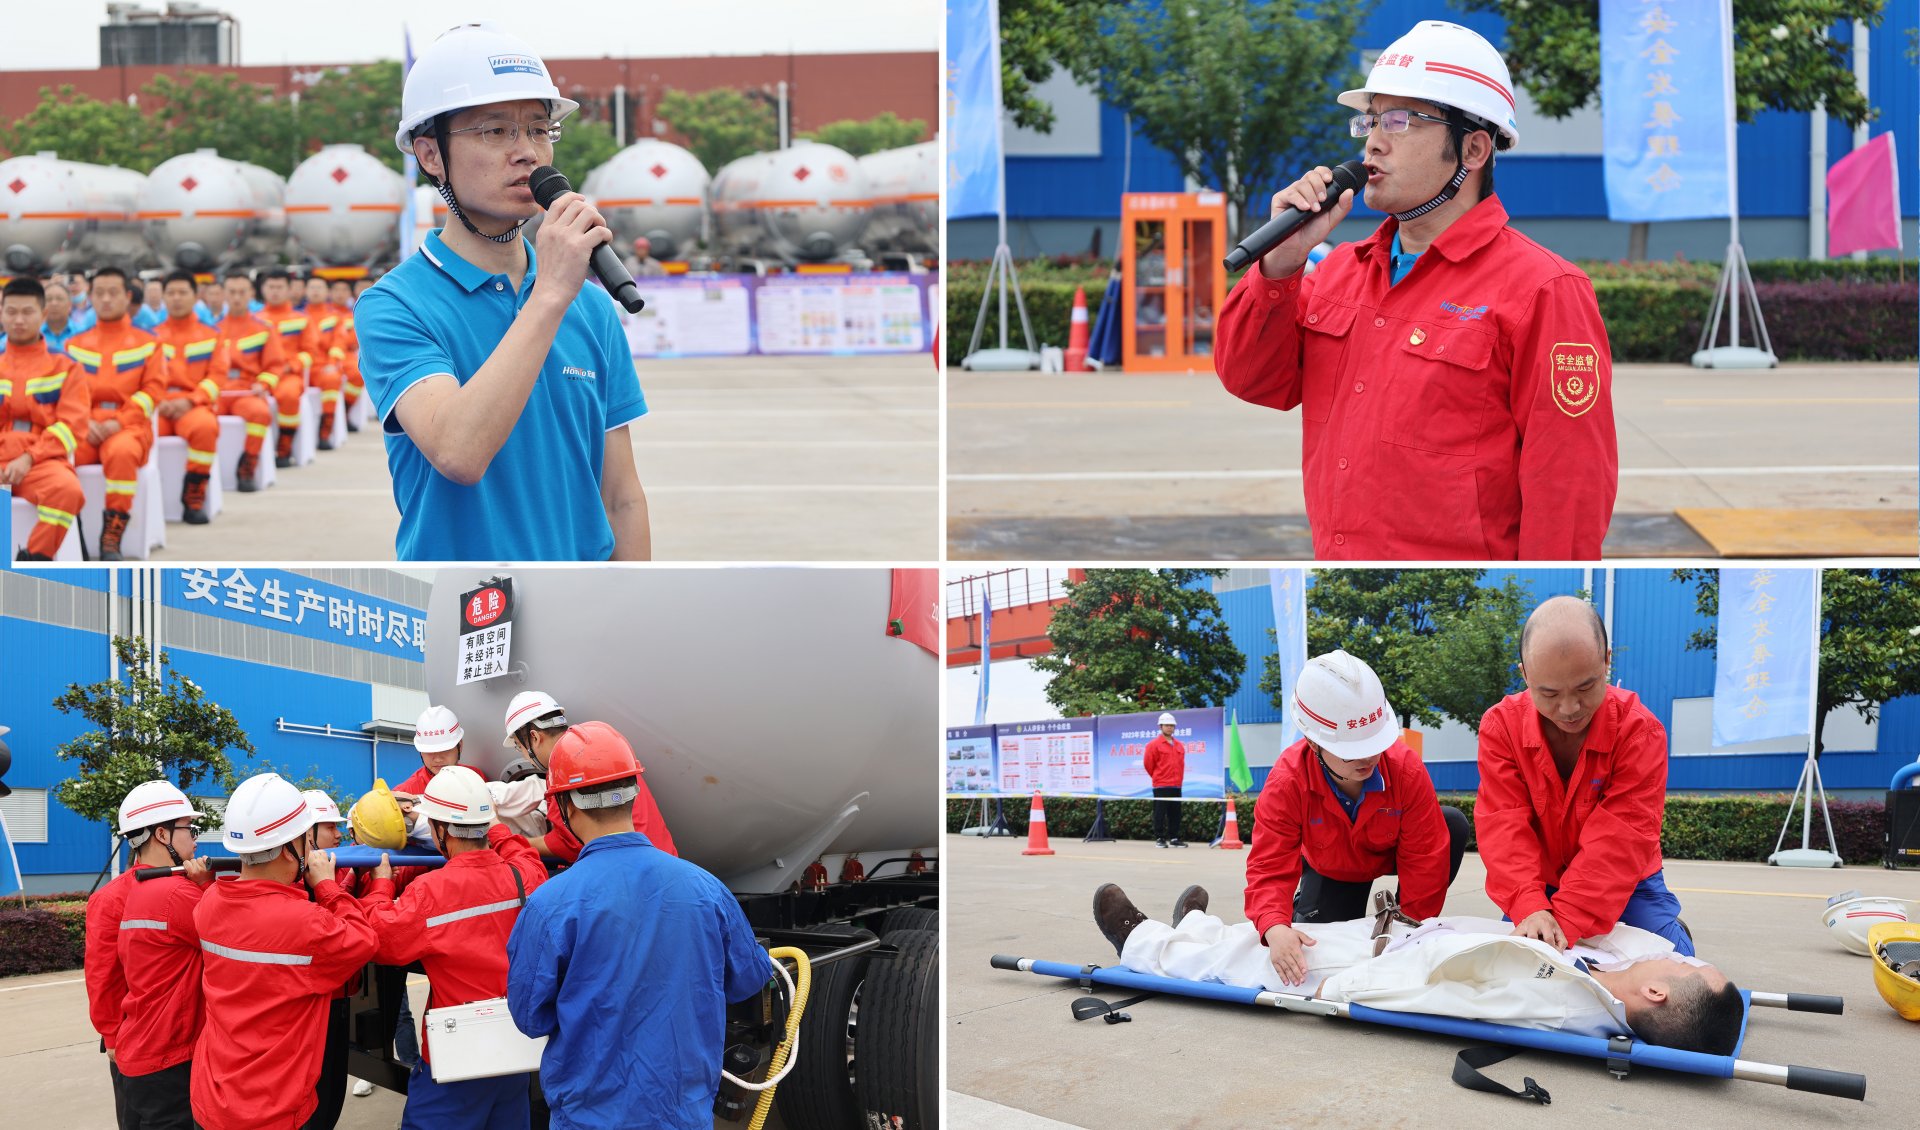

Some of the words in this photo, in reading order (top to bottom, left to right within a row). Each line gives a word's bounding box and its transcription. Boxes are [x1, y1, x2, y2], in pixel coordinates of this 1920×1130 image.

[1373, 54, 1414, 68] 全监督
[1556, 354, 1594, 366] 安全监督
[472, 590, 500, 616] 危险
[473, 611, 497, 624] DANGER
[466, 627, 506, 650] 有限空间
[465, 643, 506, 664] 未经许可
[463, 660, 503, 680] 禁止进入
[1346, 706, 1382, 730] 安全监督
